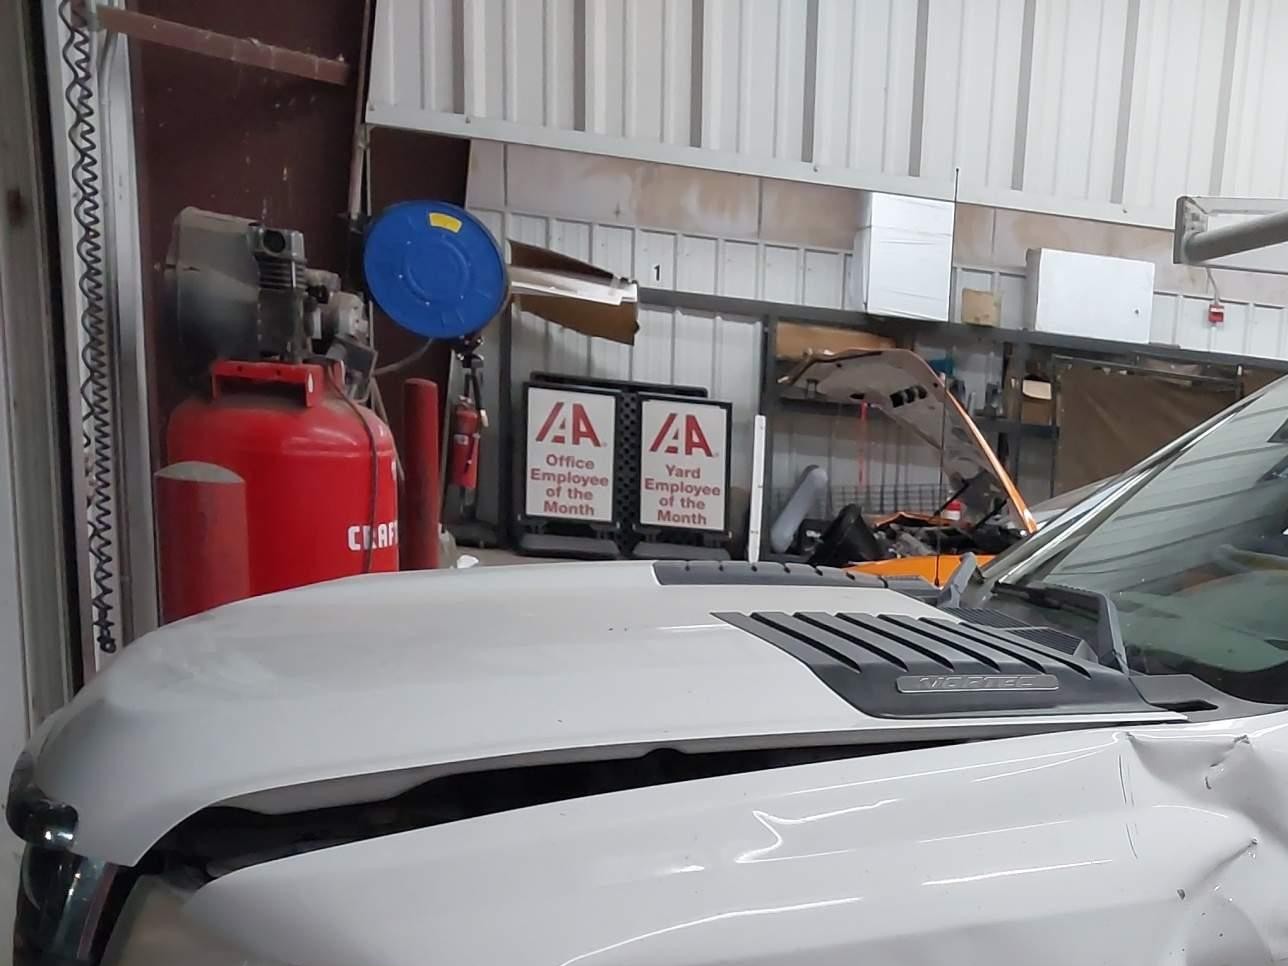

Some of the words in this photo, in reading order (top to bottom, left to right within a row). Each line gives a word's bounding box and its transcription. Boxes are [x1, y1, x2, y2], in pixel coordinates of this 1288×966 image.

[654, 264, 661, 281] 1
[546, 453, 595, 470] Office
[530, 468, 609, 488] Employee
[665, 463, 701, 480] Yard
[546, 486, 565, 500] of
[567, 486, 594, 502] the
[644, 478, 721, 497] Employee
[543, 500, 595, 517] Month
[659, 494, 675, 509] of
[680, 496, 706, 511] the
[657, 508, 707, 526] Month
